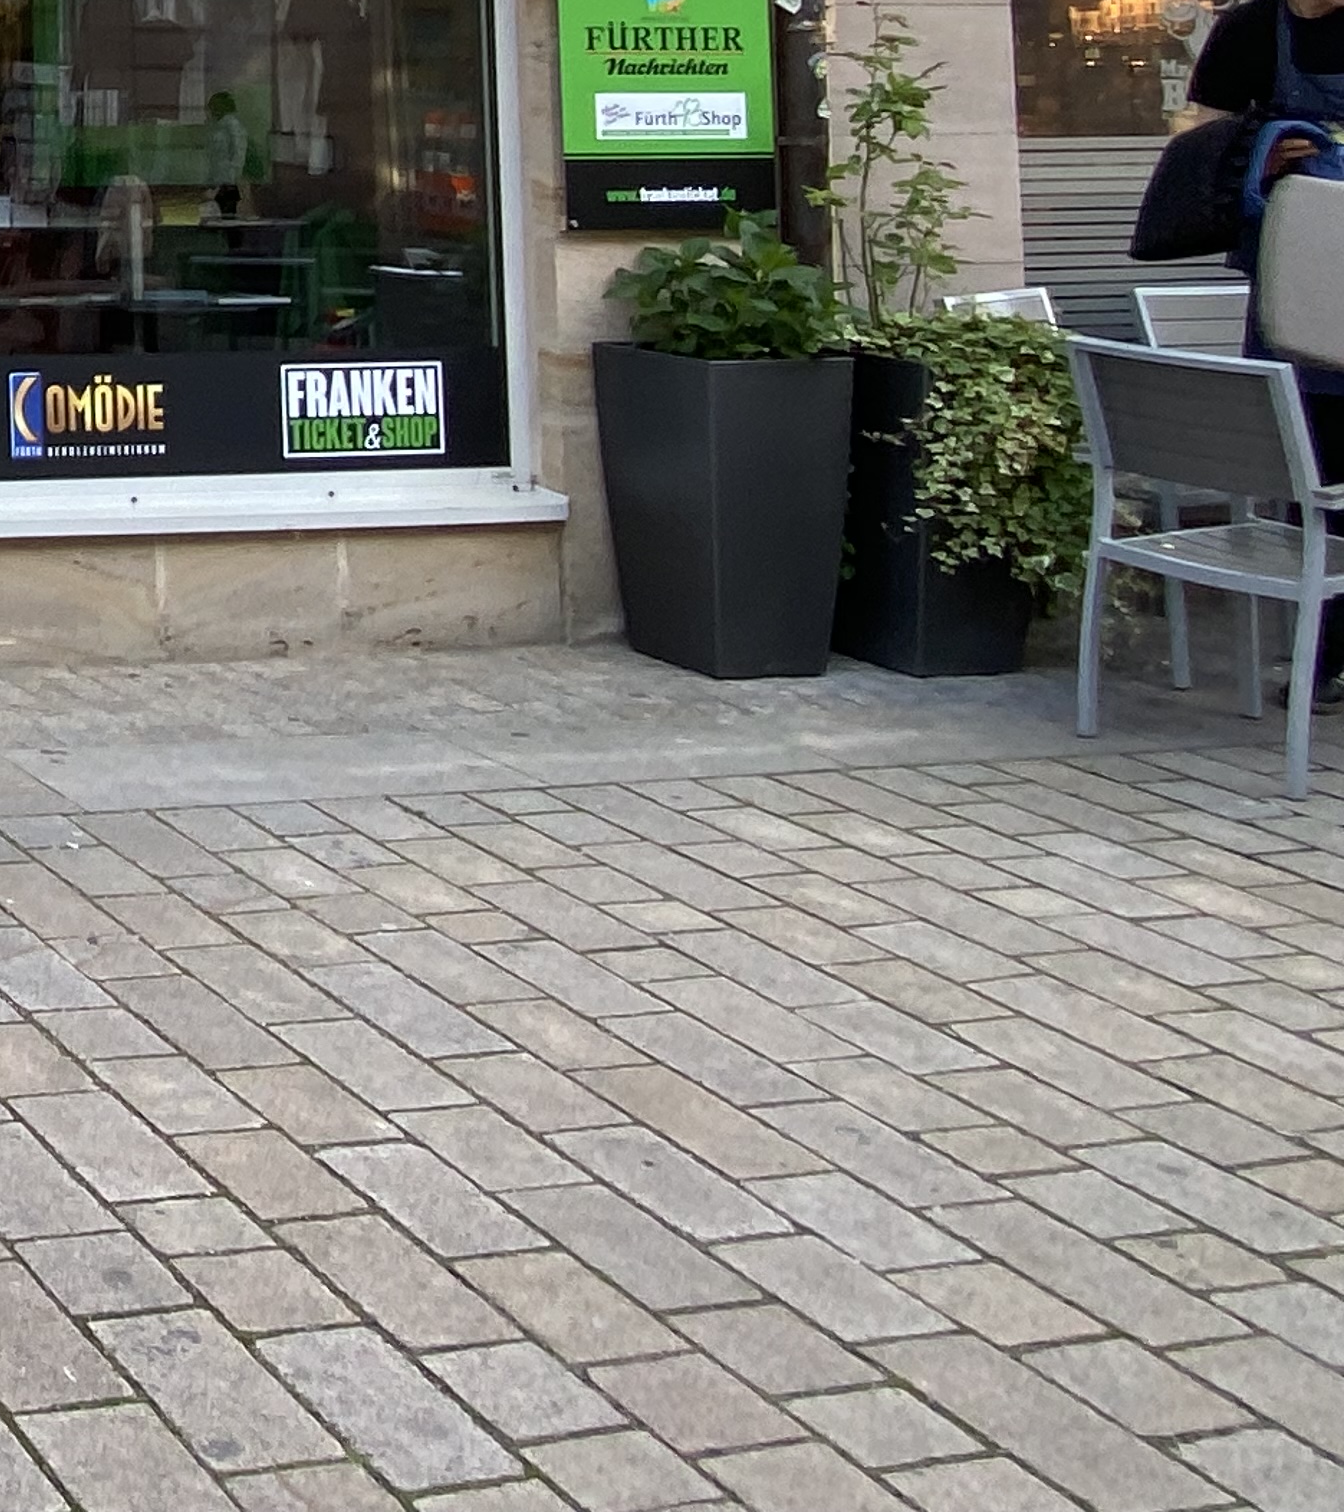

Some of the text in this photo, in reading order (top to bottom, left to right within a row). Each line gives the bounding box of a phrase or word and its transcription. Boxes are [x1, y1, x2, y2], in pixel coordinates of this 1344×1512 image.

[585, 20, 744, 52] FÜRTHER
[603, 57, 728, 76] Nachrichten
[635, 111, 678, 126] Fürth
[703, 110, 742, 130] Shop
[289, 367, 436, 417] FRANKEN
[290, 415, 438, 451] TICKET&SHOP
